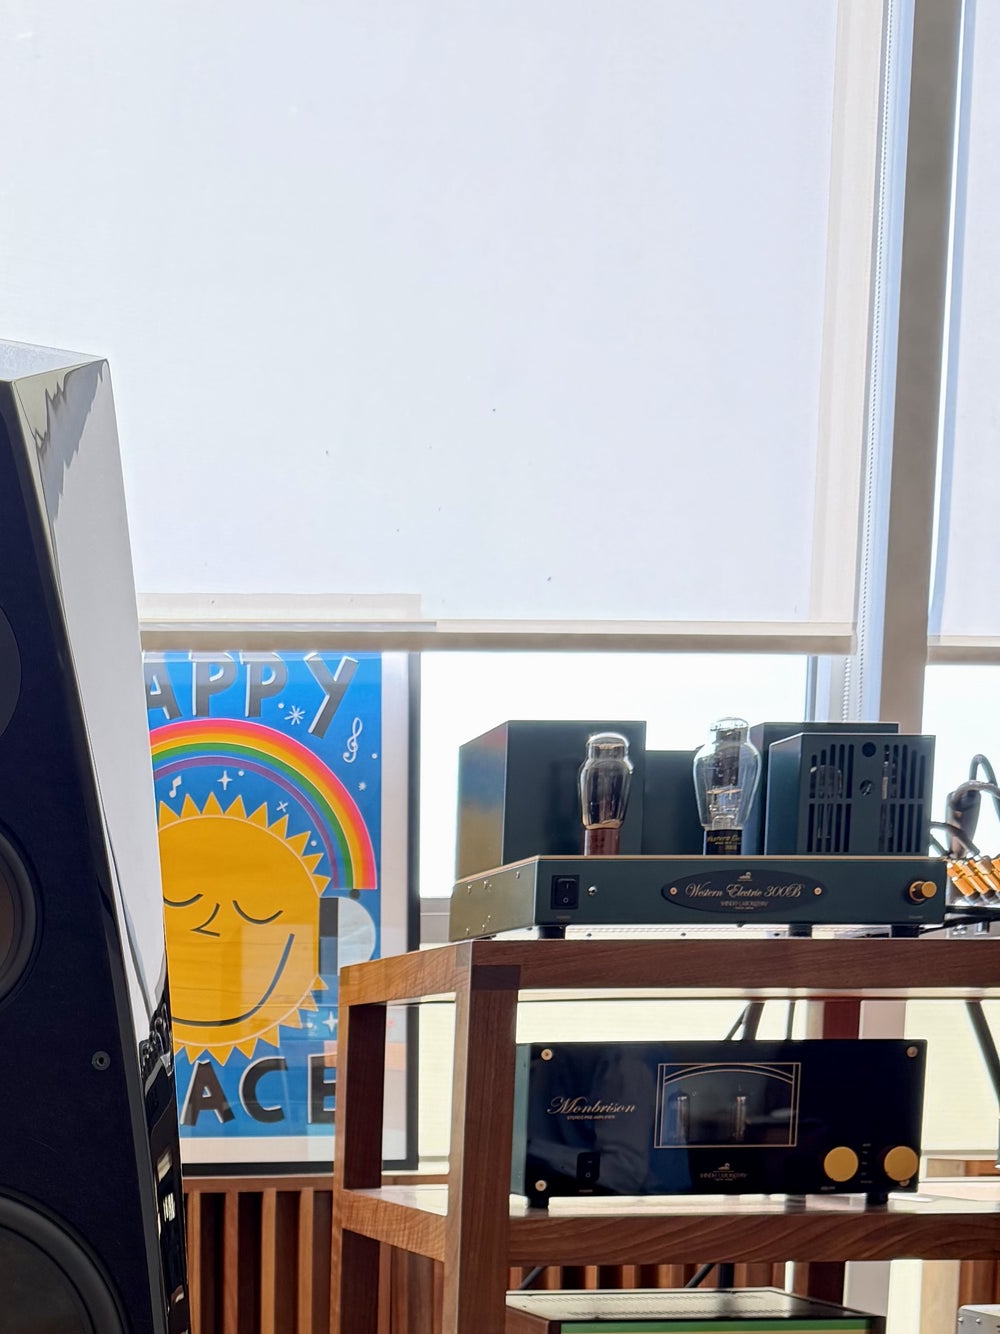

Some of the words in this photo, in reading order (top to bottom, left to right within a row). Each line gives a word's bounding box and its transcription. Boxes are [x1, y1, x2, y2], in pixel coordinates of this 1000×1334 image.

[685, 881, 723, 897] Western
[726, 883, 762, 898] Electric
[764, 883, 805, 898] 300B
[547, 1096, 636, 1114] Monbrison
